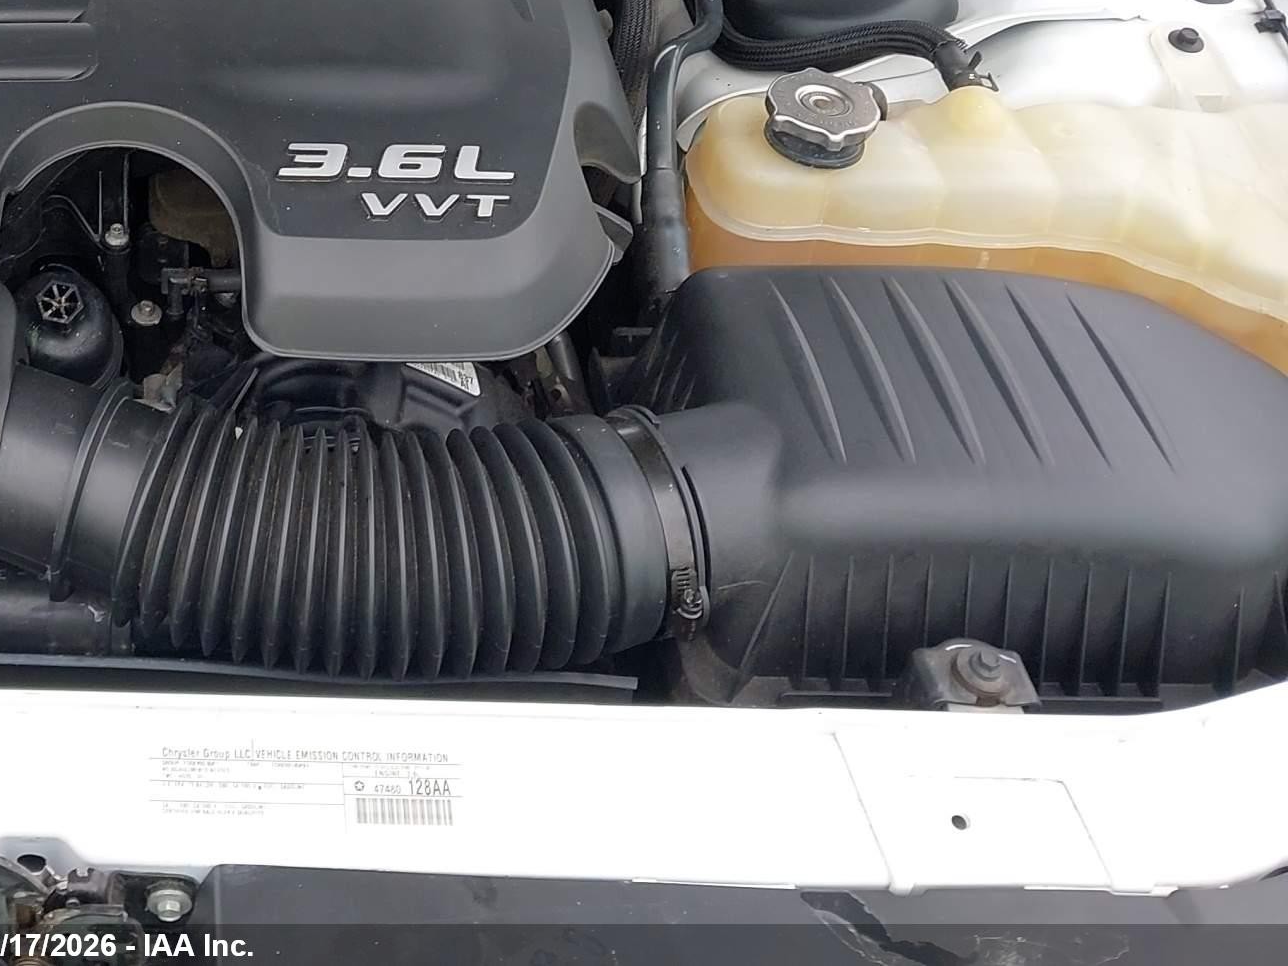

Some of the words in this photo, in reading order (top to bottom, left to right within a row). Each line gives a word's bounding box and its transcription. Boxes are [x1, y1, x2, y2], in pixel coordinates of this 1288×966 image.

[277, 142, 516, 180] 3.6L
[360, 192, 512, 218] VVT
[161, 746, 200, 761] Chrysler
[202, 747, 231, 762] Group
[233, 748, 252, 760] LLC
[255, 749, 293, 761] VEHICLE
[295, 750, 339, 761] EMISSION
[342, 751, 382, 762] CONTROL
[386, 752, 449, 763] INFORMATION
[408, 779, 452, 796] 128AA
